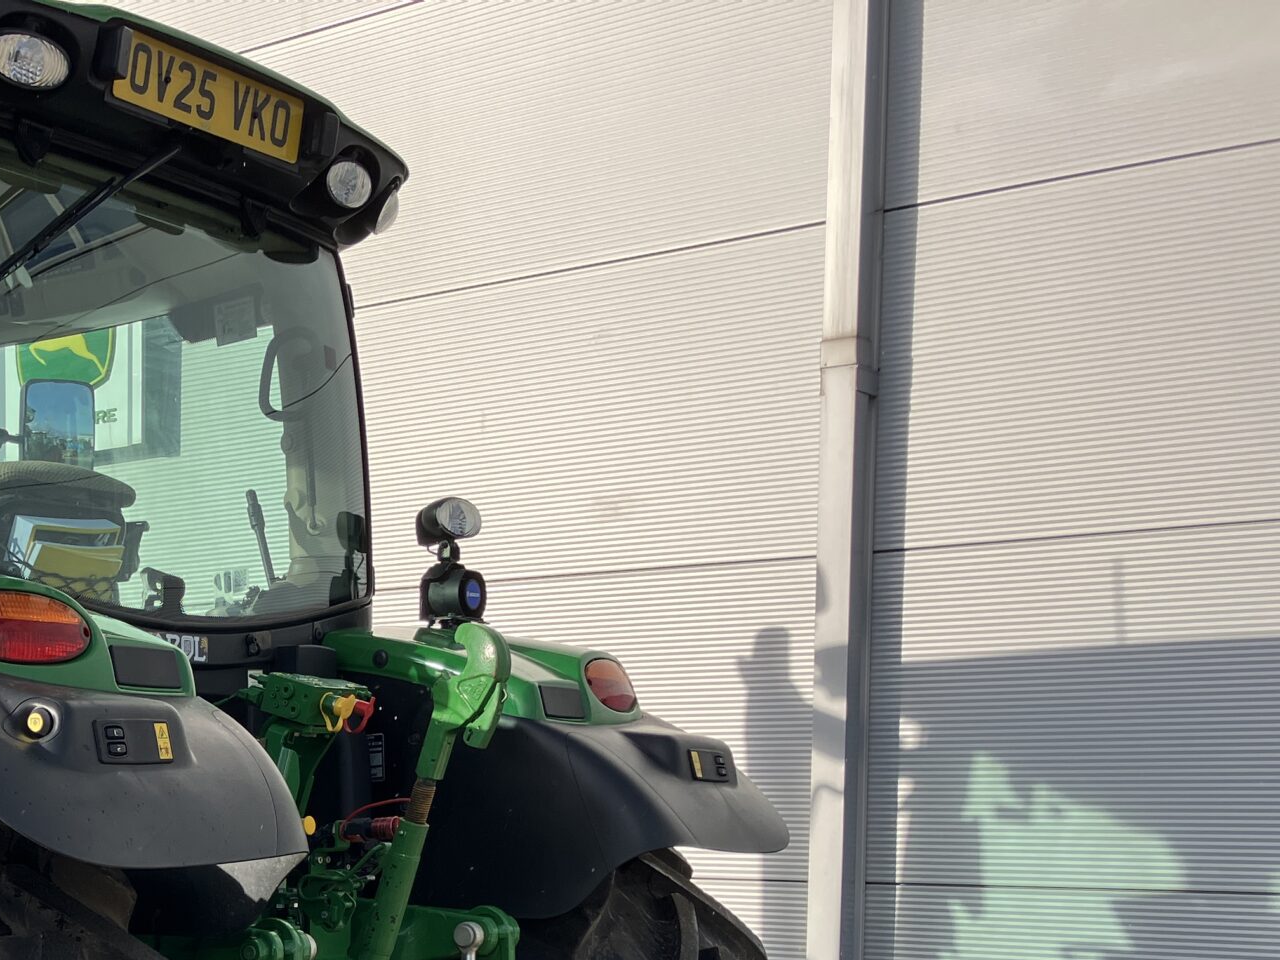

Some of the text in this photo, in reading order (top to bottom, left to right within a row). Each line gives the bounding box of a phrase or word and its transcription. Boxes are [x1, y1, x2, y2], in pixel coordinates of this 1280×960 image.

[130, 42, 291, 148] OV25 VKO
[95, 408, 117, 424] RE
